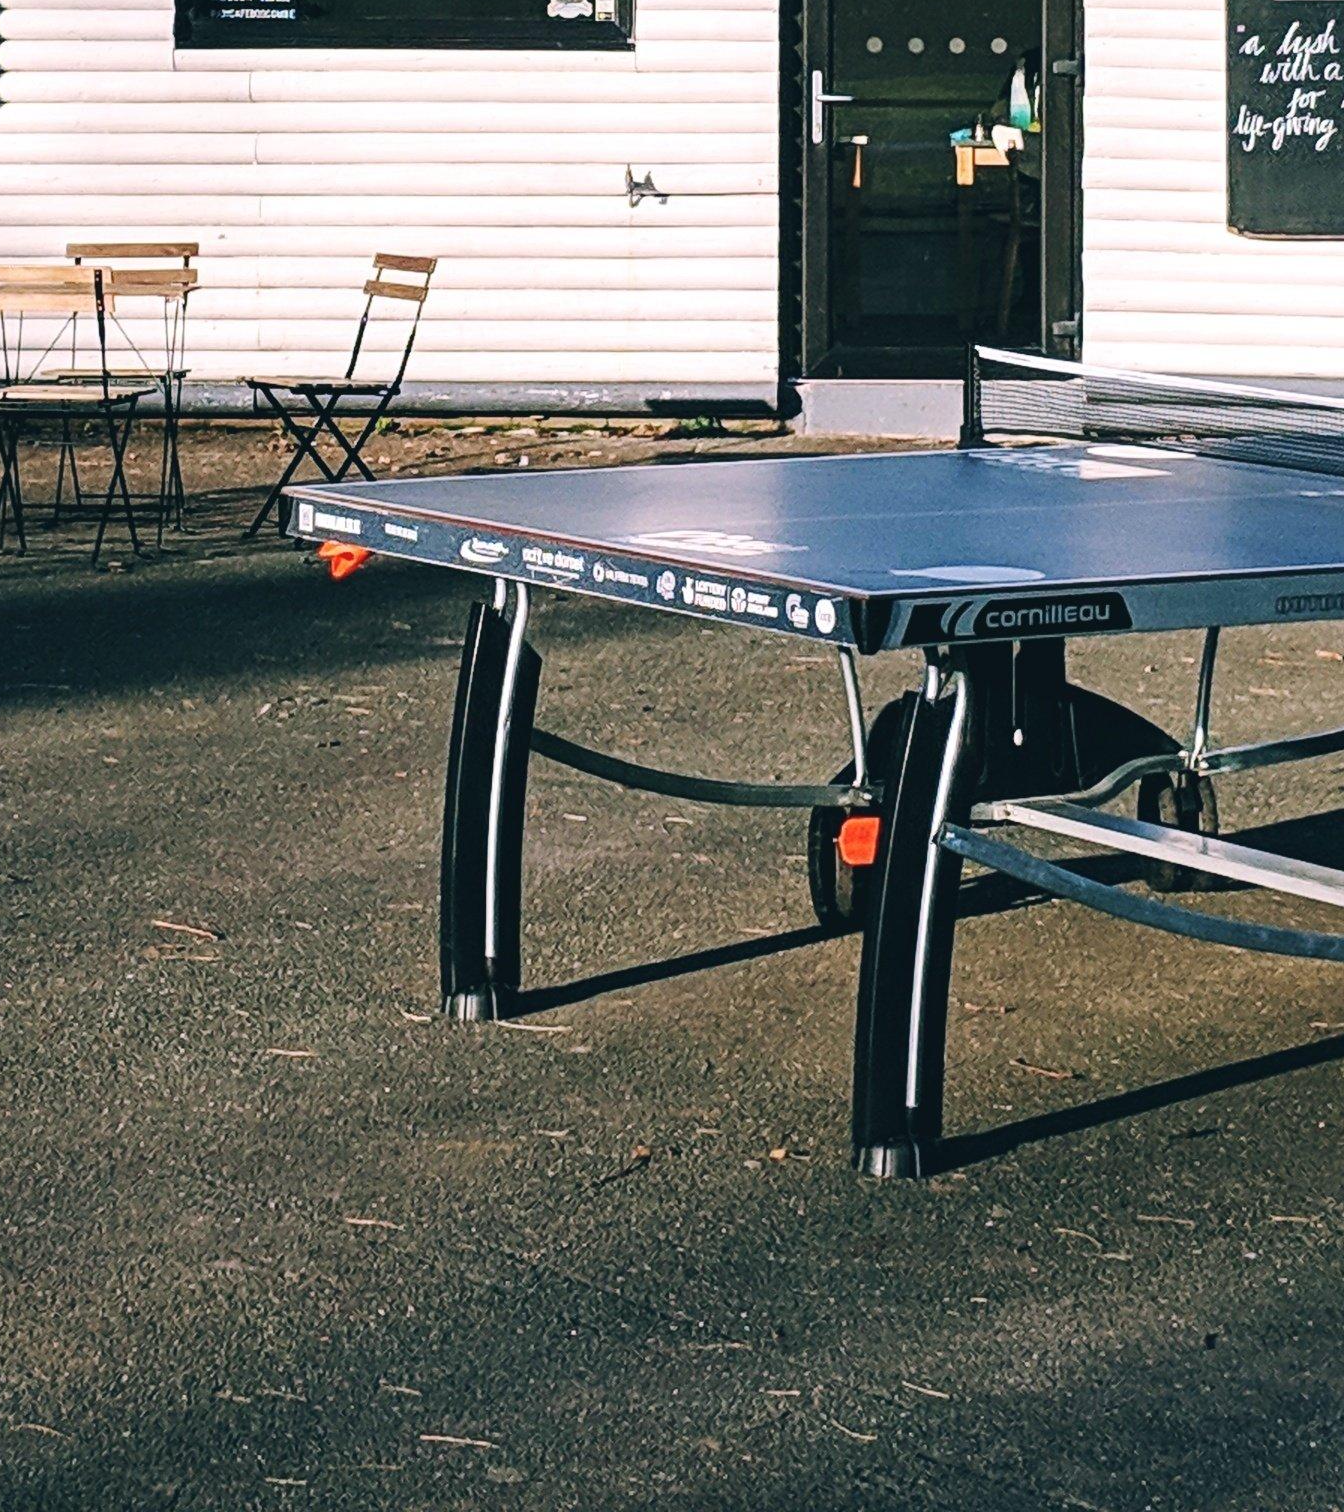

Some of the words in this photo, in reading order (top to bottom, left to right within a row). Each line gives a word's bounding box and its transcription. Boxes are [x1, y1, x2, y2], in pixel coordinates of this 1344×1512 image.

[1276, 19, 1341, 56] lush
[1259, 51, 1321, 85] with
[1323, 61, 1344, 82] a
[1286, 87, 1327, 119] for
[1232, 103, 1339, 153] life-giving
[985, 604, 1111, 628] cornilleau
